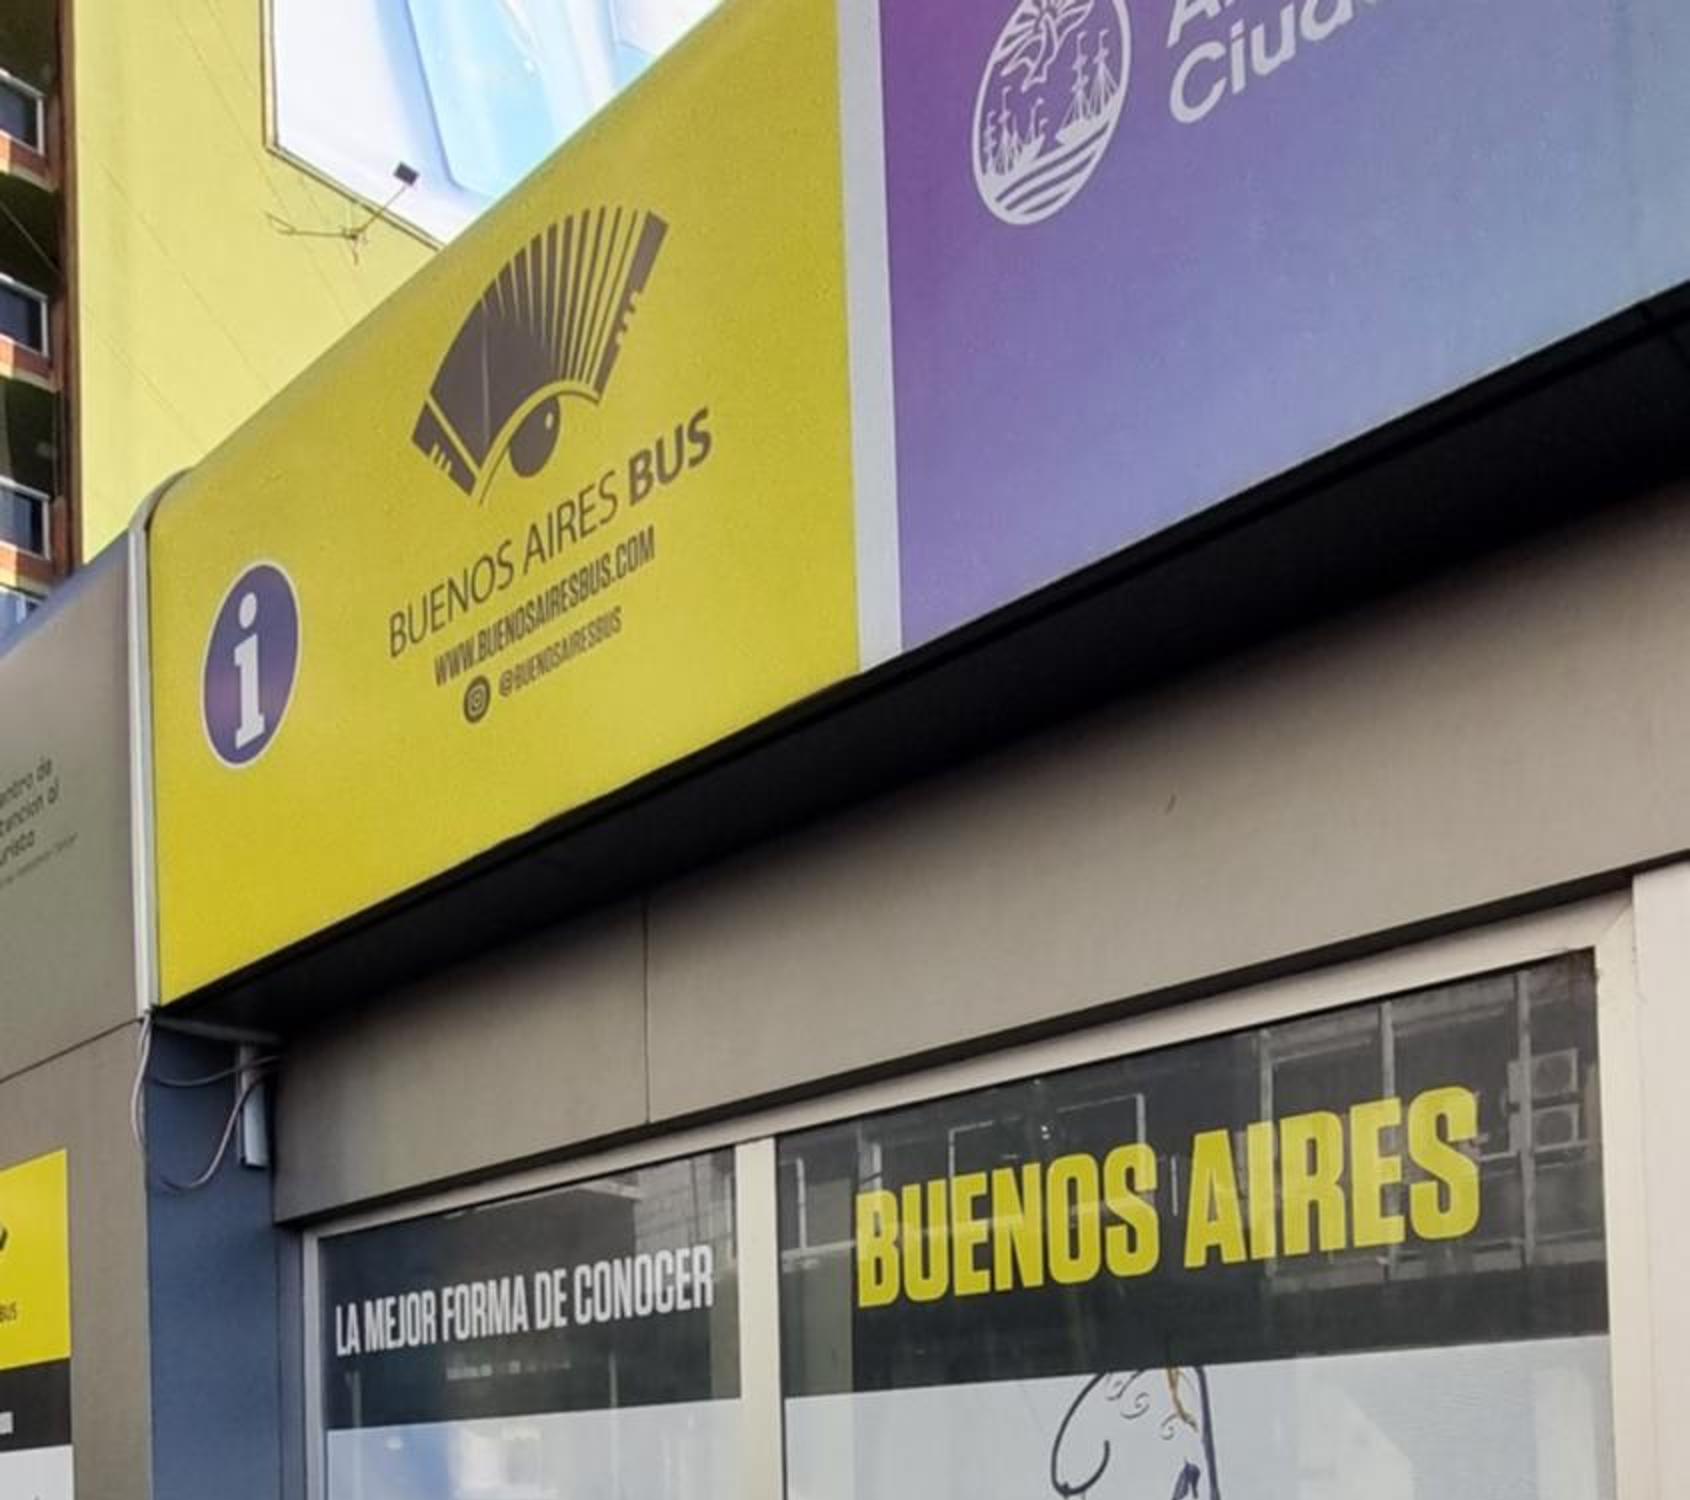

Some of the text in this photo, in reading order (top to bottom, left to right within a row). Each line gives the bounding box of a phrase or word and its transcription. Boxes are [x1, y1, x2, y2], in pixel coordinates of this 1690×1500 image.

[388, 407, 713, 659] BUENOS AIRES BUS
[434, 524, 656, 687] WWW.BUENOSAIRESBUS.COM
[855, 1084, 1480, 1309] BUENOS AIRES
[335, 1244, 715, 1357] LA MEJOR FORMA DE CONOCER
